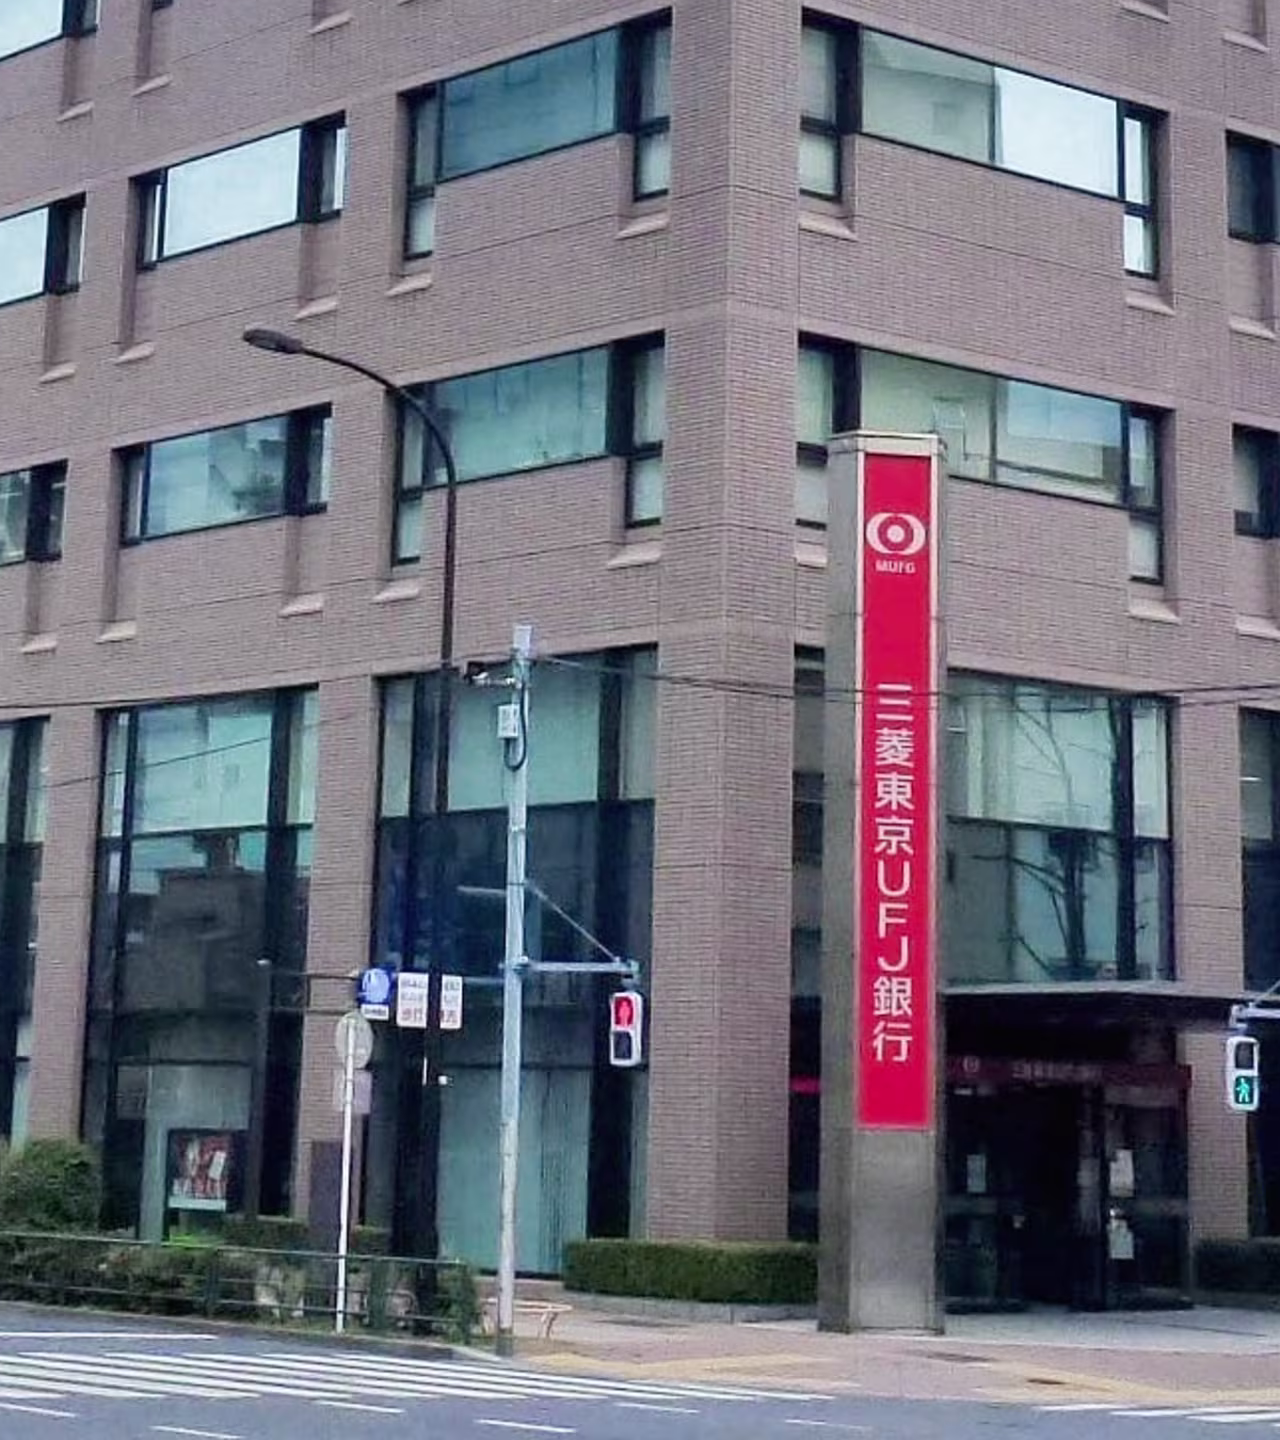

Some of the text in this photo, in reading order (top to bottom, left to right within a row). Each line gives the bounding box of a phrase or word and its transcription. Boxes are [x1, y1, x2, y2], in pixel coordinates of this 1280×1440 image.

[875, 559, 916, 574] MUFG
[872, 681, 915, 1062] 三菱東京UFJ銀行
